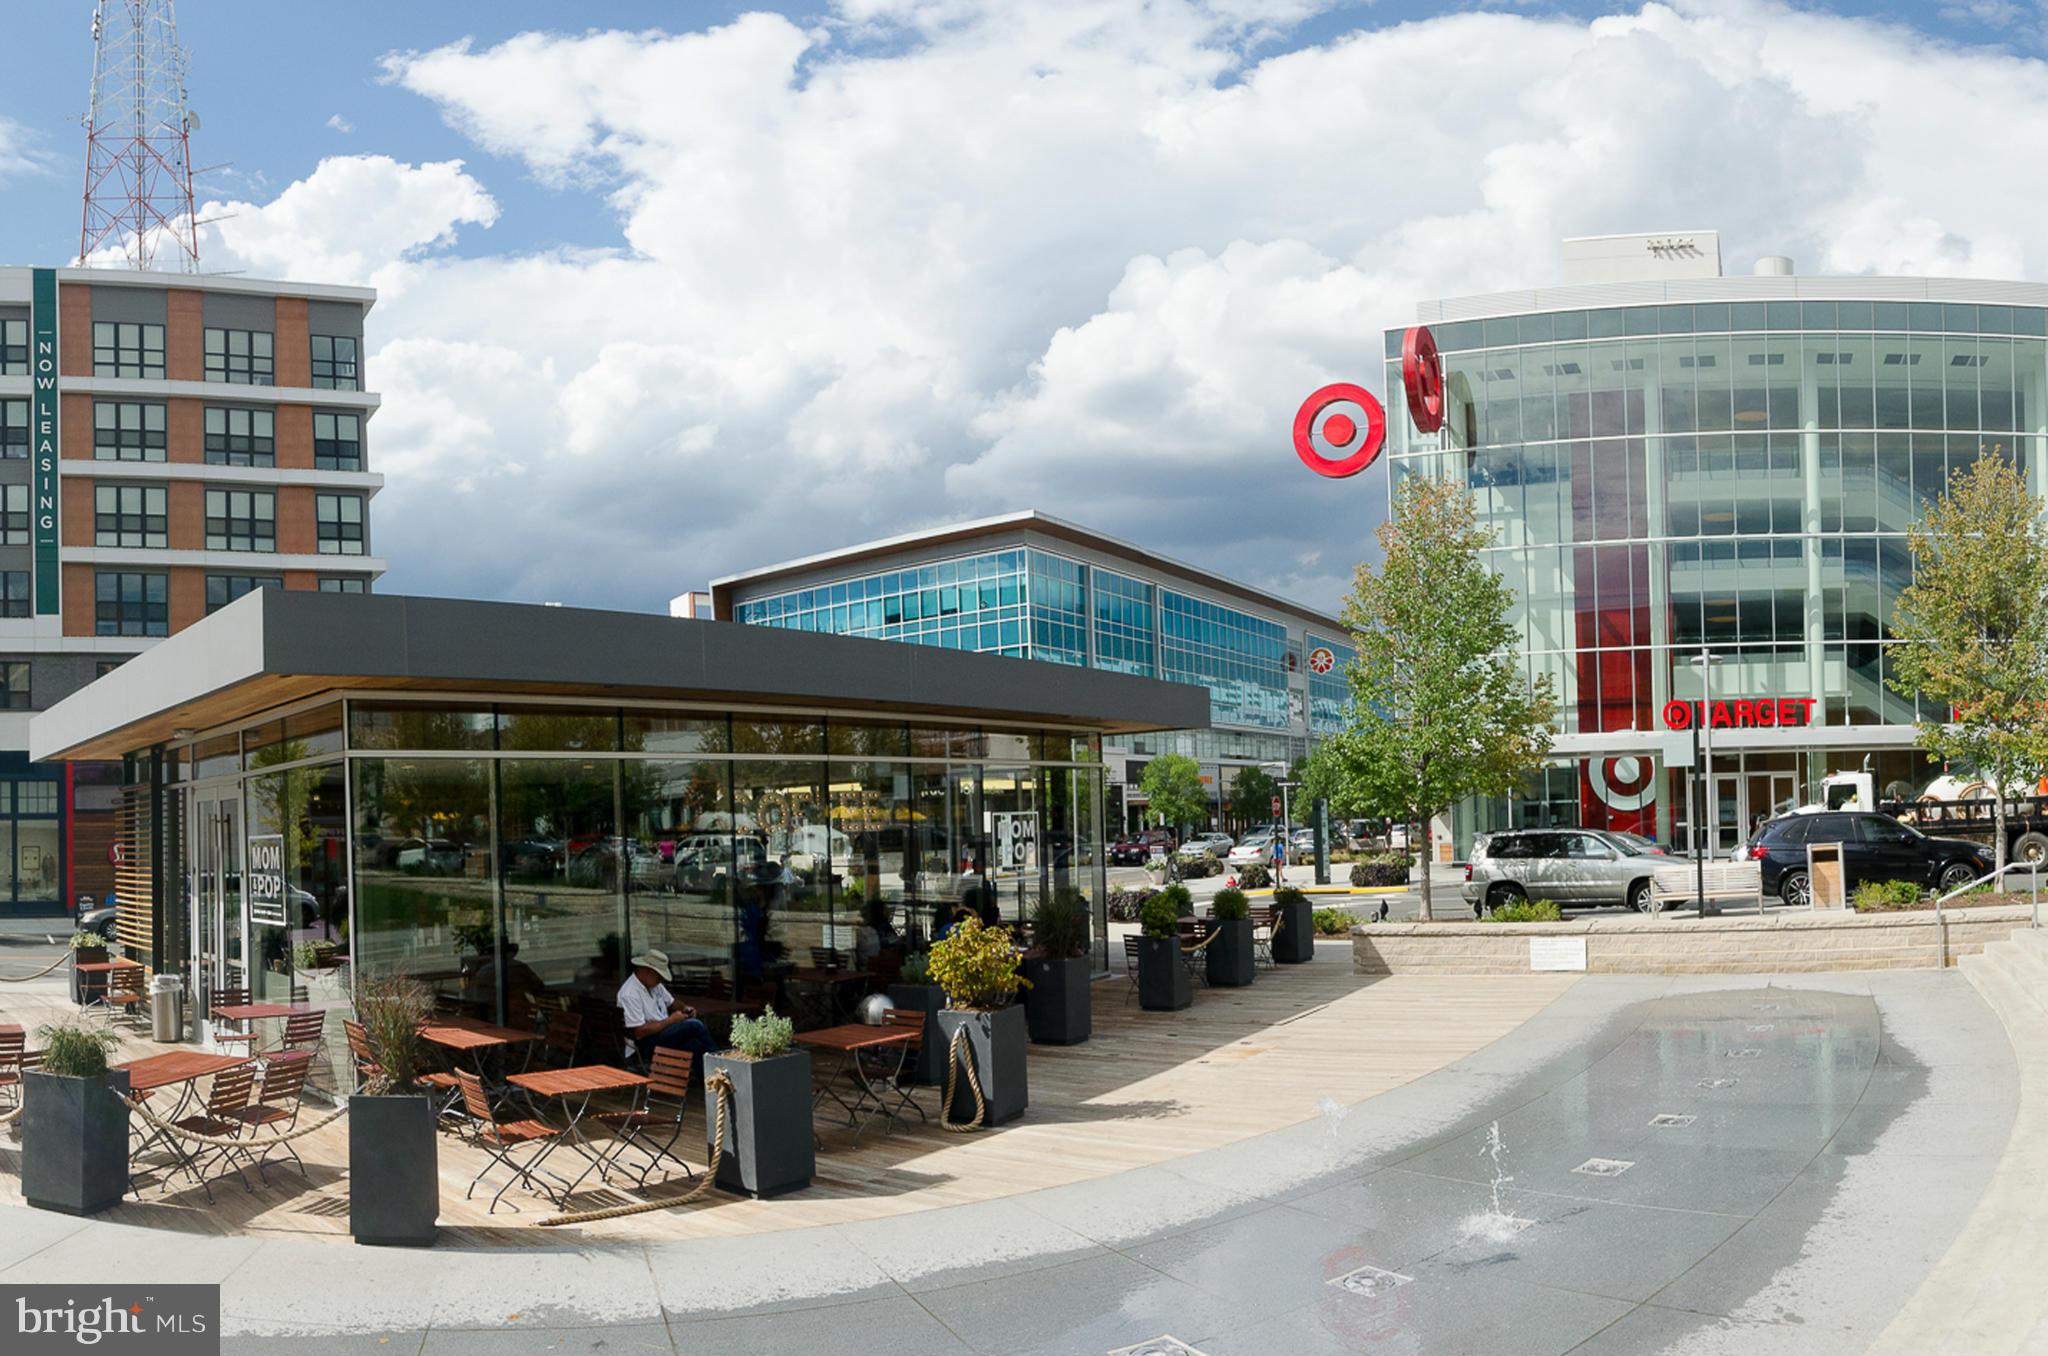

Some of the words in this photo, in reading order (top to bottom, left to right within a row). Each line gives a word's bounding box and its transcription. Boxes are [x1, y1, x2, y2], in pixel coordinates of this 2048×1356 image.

[37, 342, 55, 389] NOW
[40, 403, 53, 529] LEASING
[1698, 698, 1817, 726] TARGET
[730, 789, 881, 834] OFEE
[252, 846, 280, 870] MOM
